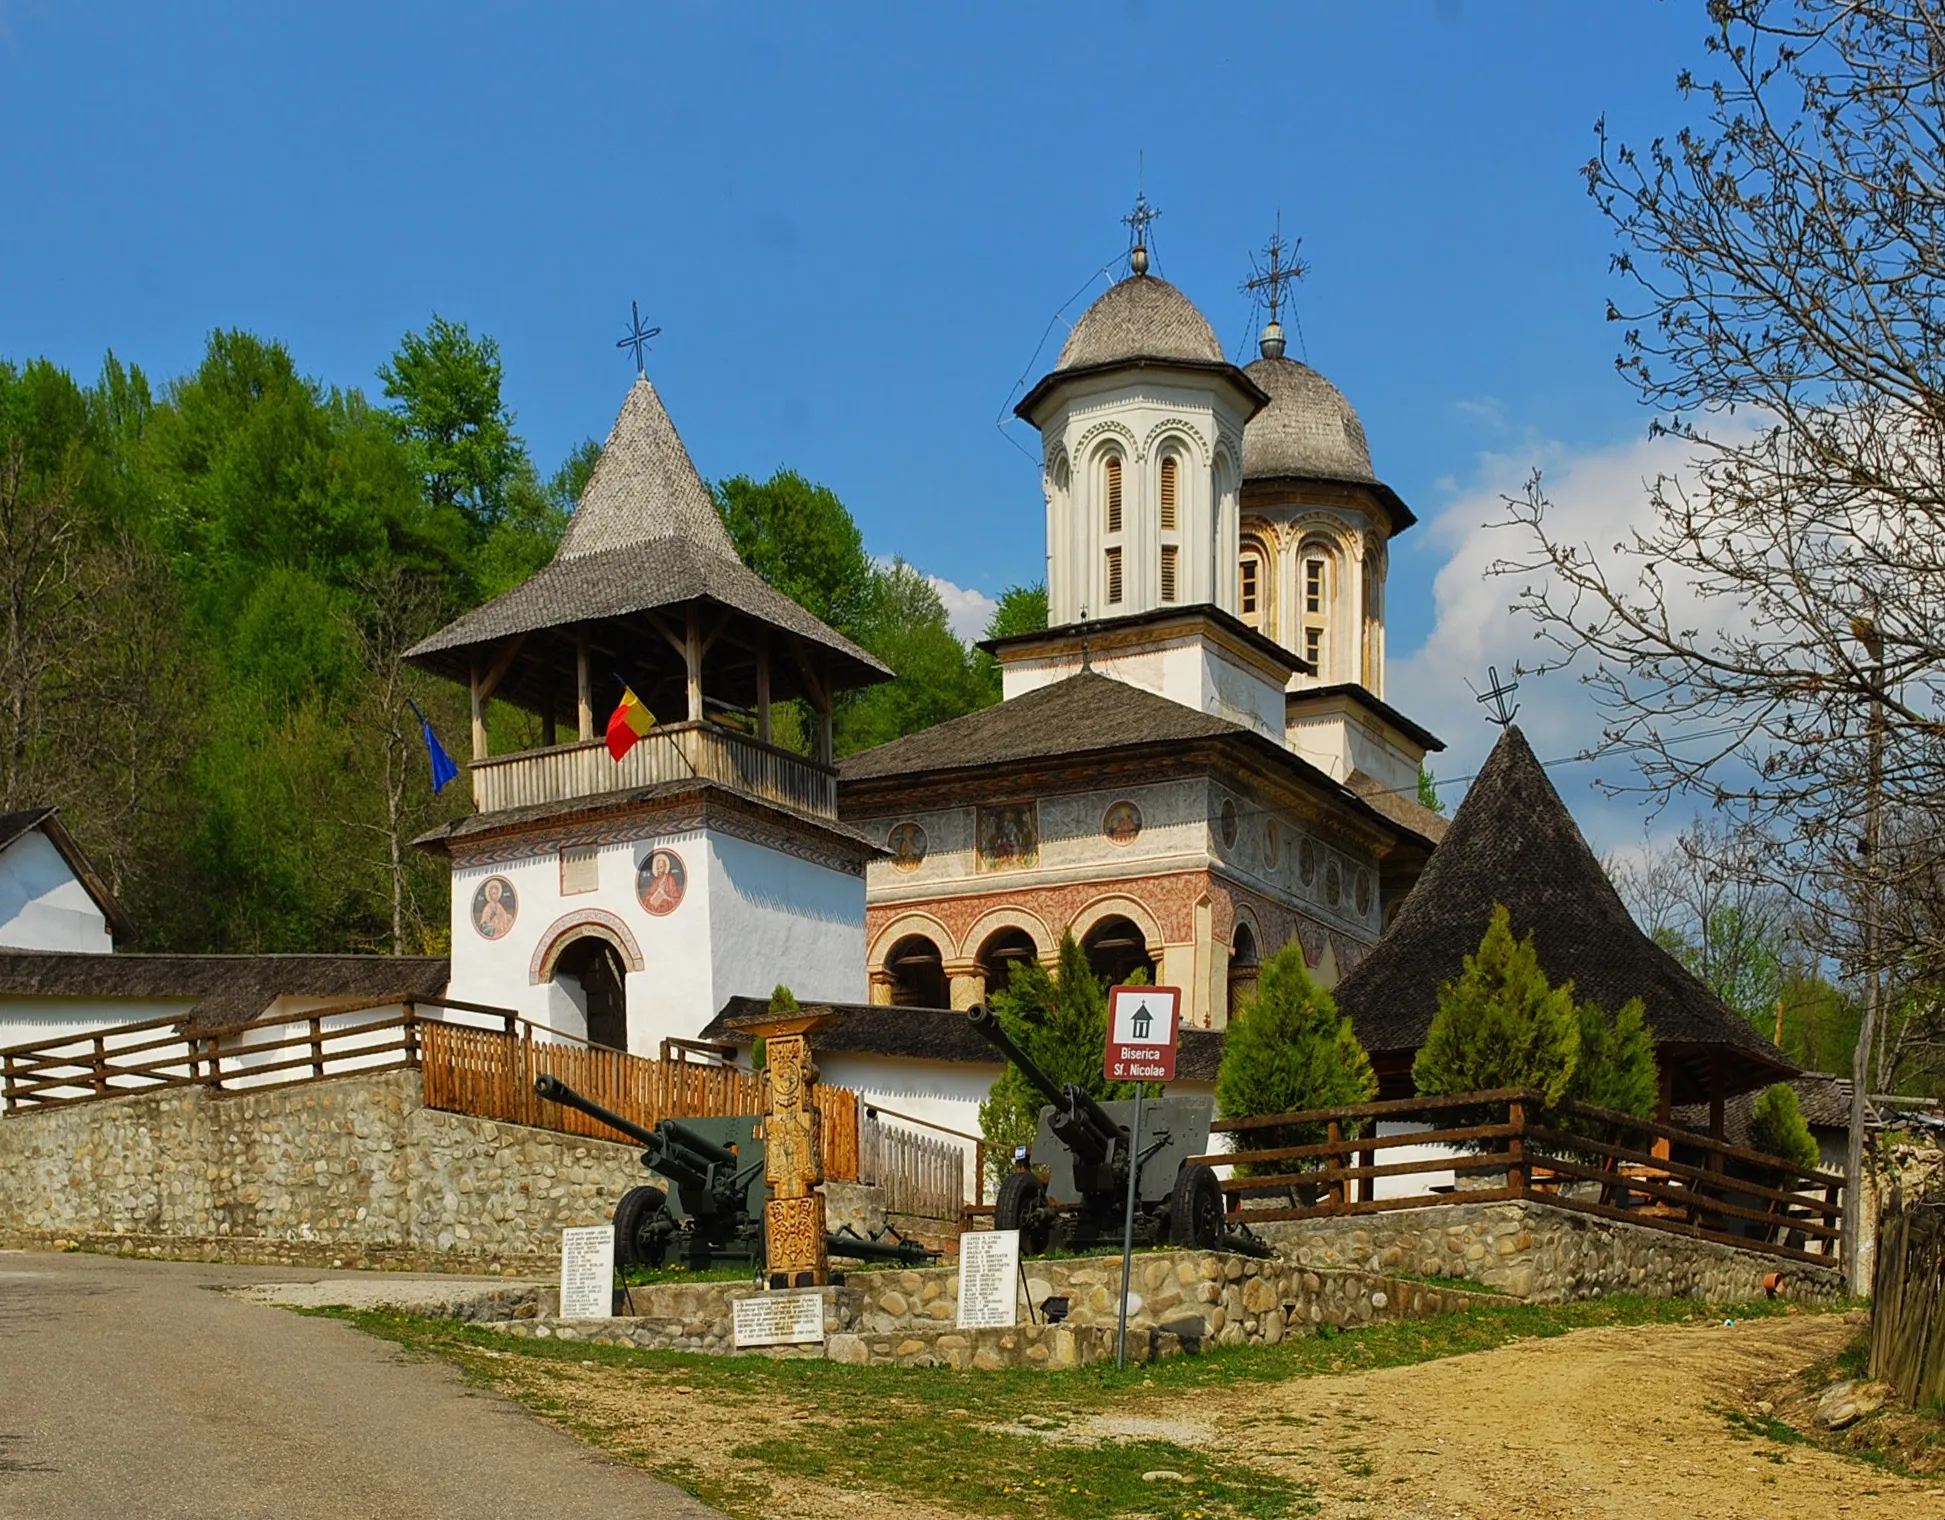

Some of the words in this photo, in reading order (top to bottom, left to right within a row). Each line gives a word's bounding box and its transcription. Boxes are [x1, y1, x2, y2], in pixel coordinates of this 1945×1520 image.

[1121, 1047, 1160, 1060] Biserica
[1113, 1063, 1127, 1076] Sf.
[1130, 1064, 1165, 1077] Nicolae
